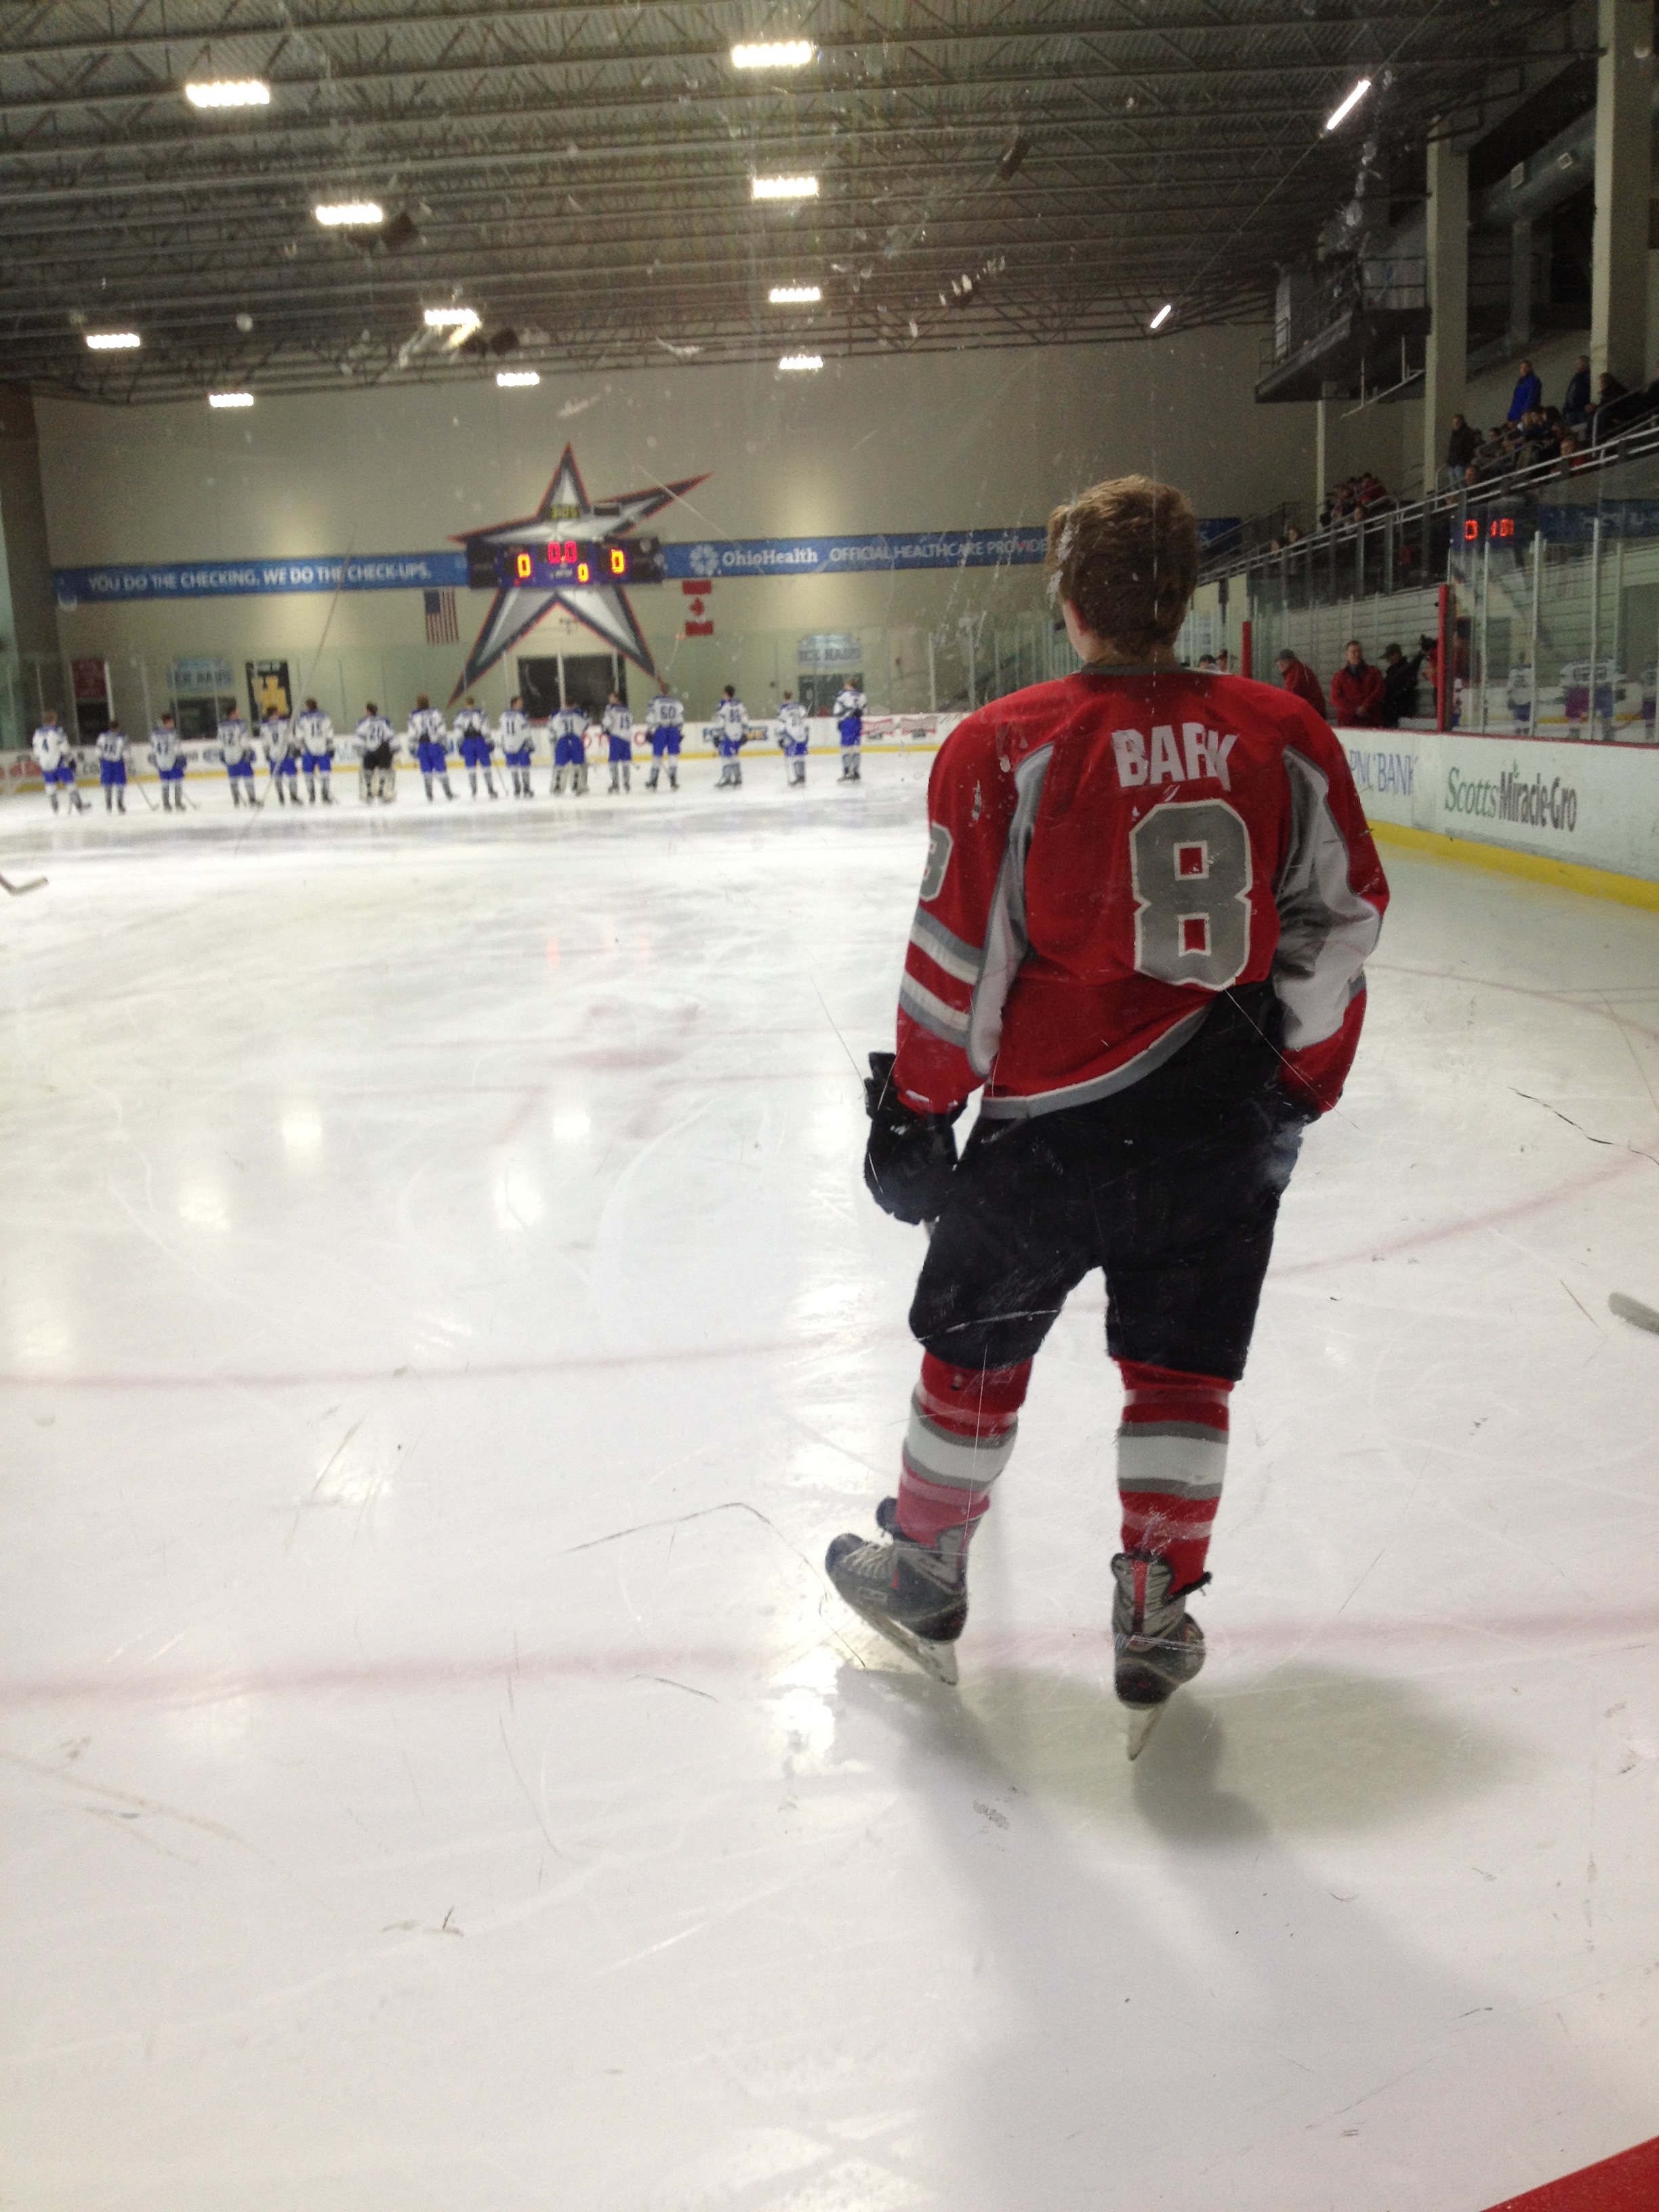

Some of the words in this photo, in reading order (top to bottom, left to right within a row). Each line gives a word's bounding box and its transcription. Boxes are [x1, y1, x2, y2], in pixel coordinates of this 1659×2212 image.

[611, 548, 625, 573] 0
[722, 548, 817, 567] OhioHealth
[830, 545, 890, 562] OFFICIAL
[894, 541, 983, 560] HEALTHCARE
[517, 553, 531, 578] 0
[577, 563, 589, 581] 0
[88, 577, 120, 592] YOU
[123, 576, 148, 592] DO
[150, 574, 176, 590] THE
[263, 567, 286, 585] WE
[289, 566, 314, 584] DO
[316, 565, 344, 583] THE
[660, 705, 676, 720] 60
[1129, 798, 1254, 992] 8
